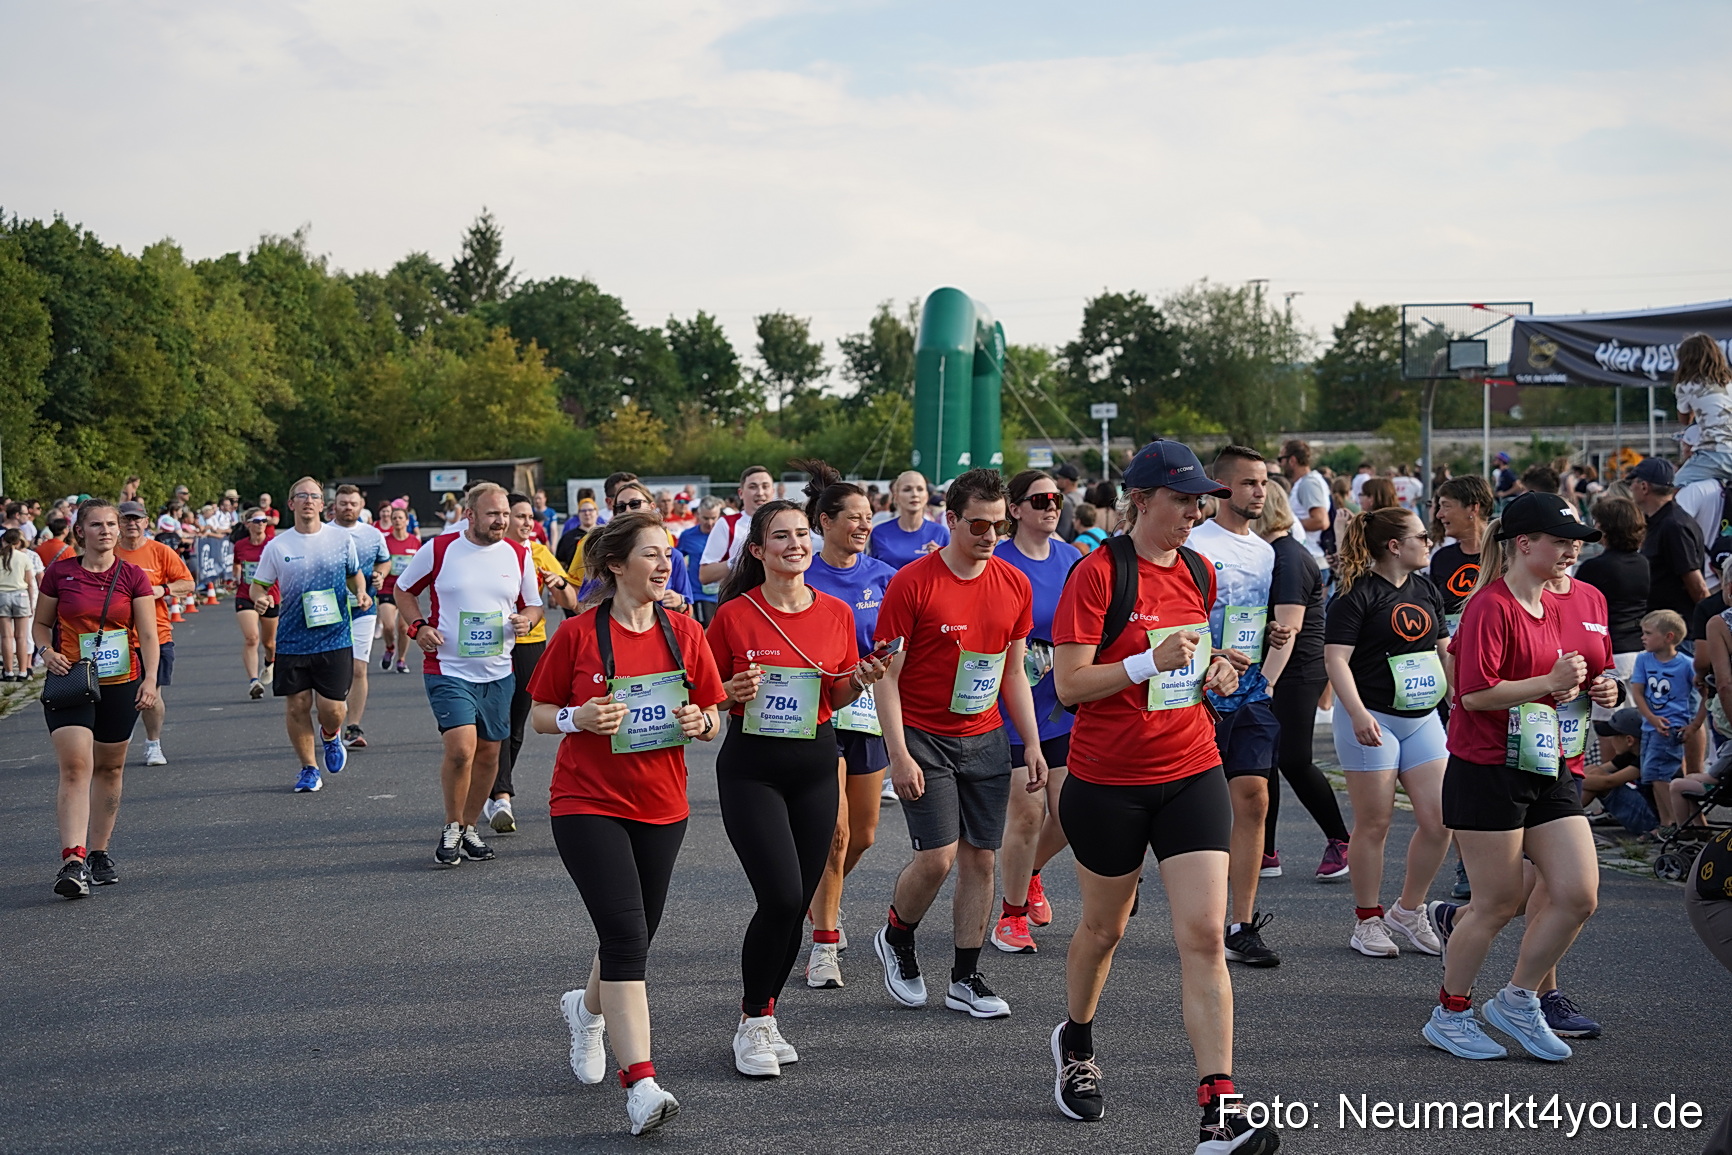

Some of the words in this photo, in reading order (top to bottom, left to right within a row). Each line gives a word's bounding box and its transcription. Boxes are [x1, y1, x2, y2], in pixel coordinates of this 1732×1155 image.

[1594, 338, 1641, 373] Hier
[311, 604, 329, 613] 275
[1139, 613, 1160, 622] ECOVIS
[950, 624, 968, 632] ECOVIS
[470, 630, 493, 641] 523
[1237, 630, 1257, 642] 317
[972, 677, 996, 692] 792
[1161, 680, 1186, 690] Daniela
[1404, 675, 1436, 691] 2748
[957, 692, 983, 700] Johannes
[765, 695, 798, 712] 784
[629, 704, 666, 724] 789
[760, 712, 784, 721] Egzona
[784, 714, 802, 723] Delija
[627, 727, 648, 735] Rama
[648, 722, 675, 731] Mardini
